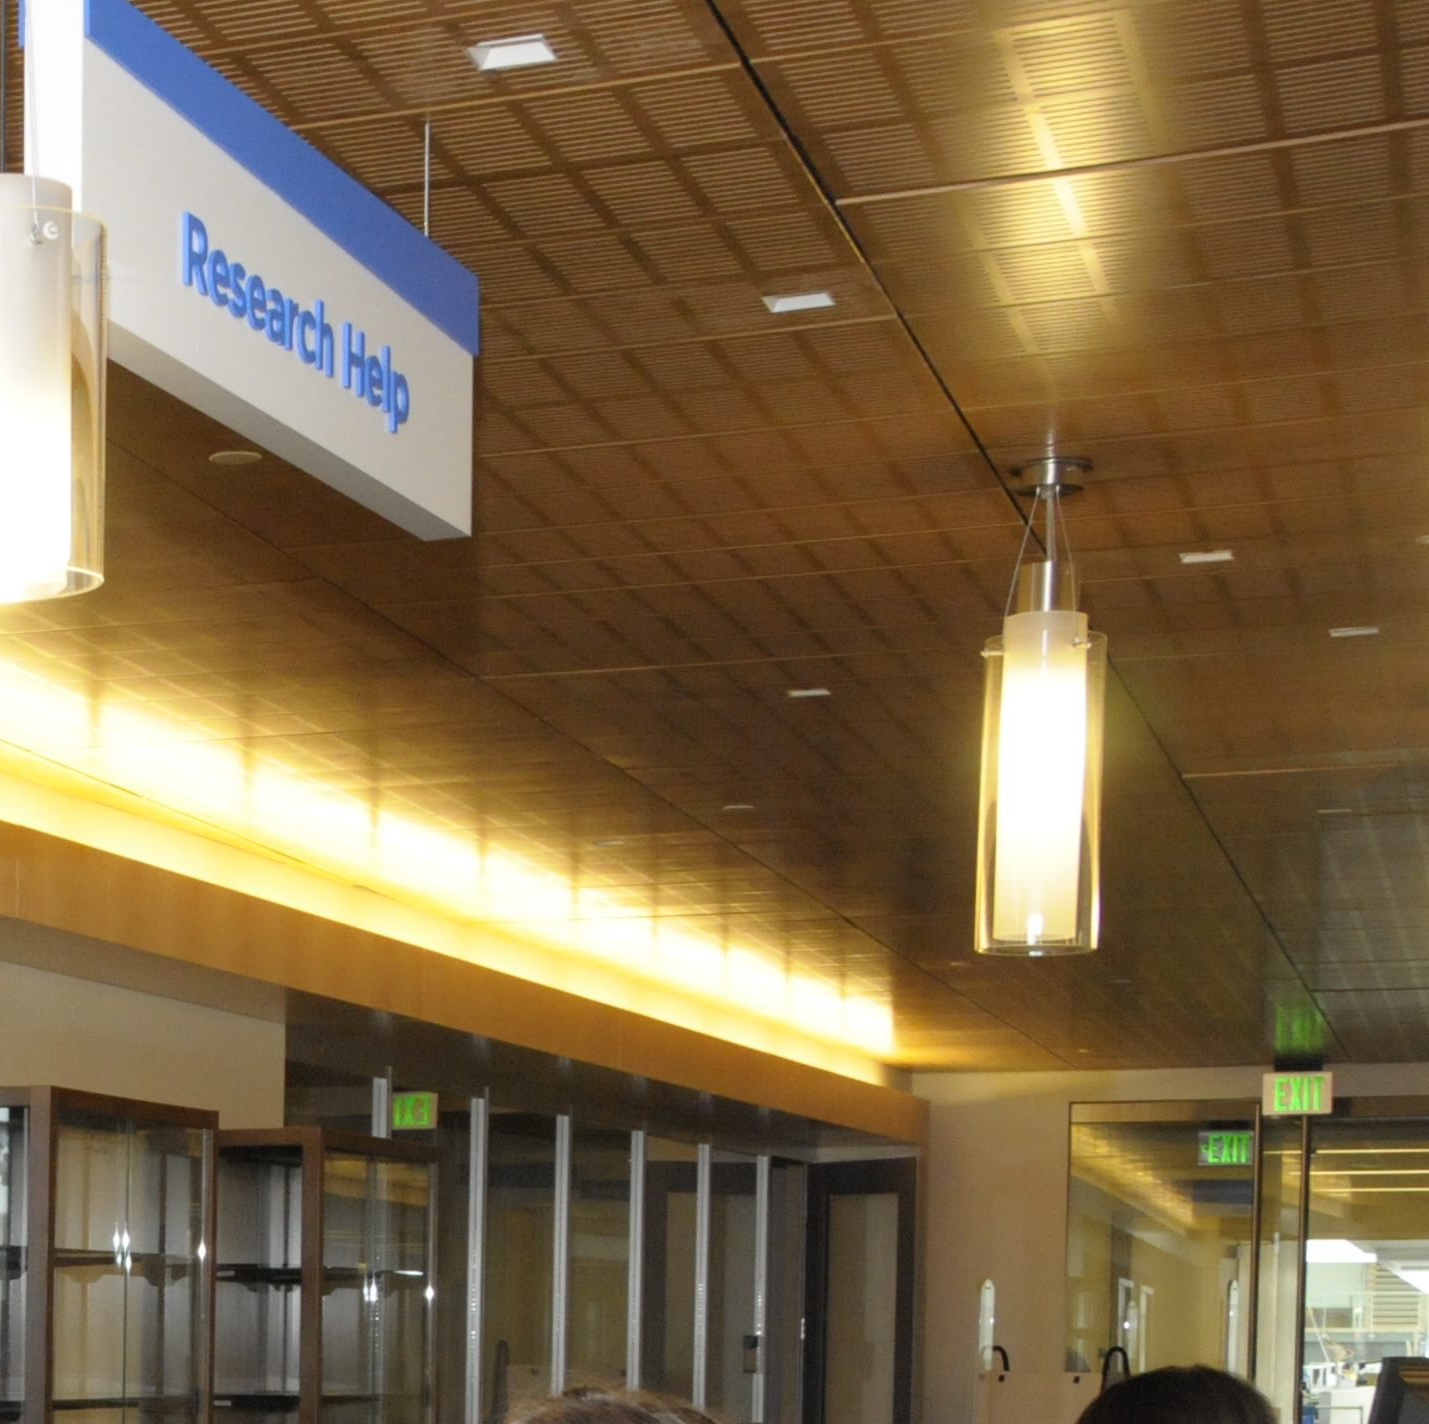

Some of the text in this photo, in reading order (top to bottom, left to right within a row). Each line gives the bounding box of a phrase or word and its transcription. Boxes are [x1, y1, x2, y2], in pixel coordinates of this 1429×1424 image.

[181, 210, 410, 433] Research Help
[1274, 1076, 1325, 1112] EXIT
[1207, 1133, 1251, 1163] EXIT
